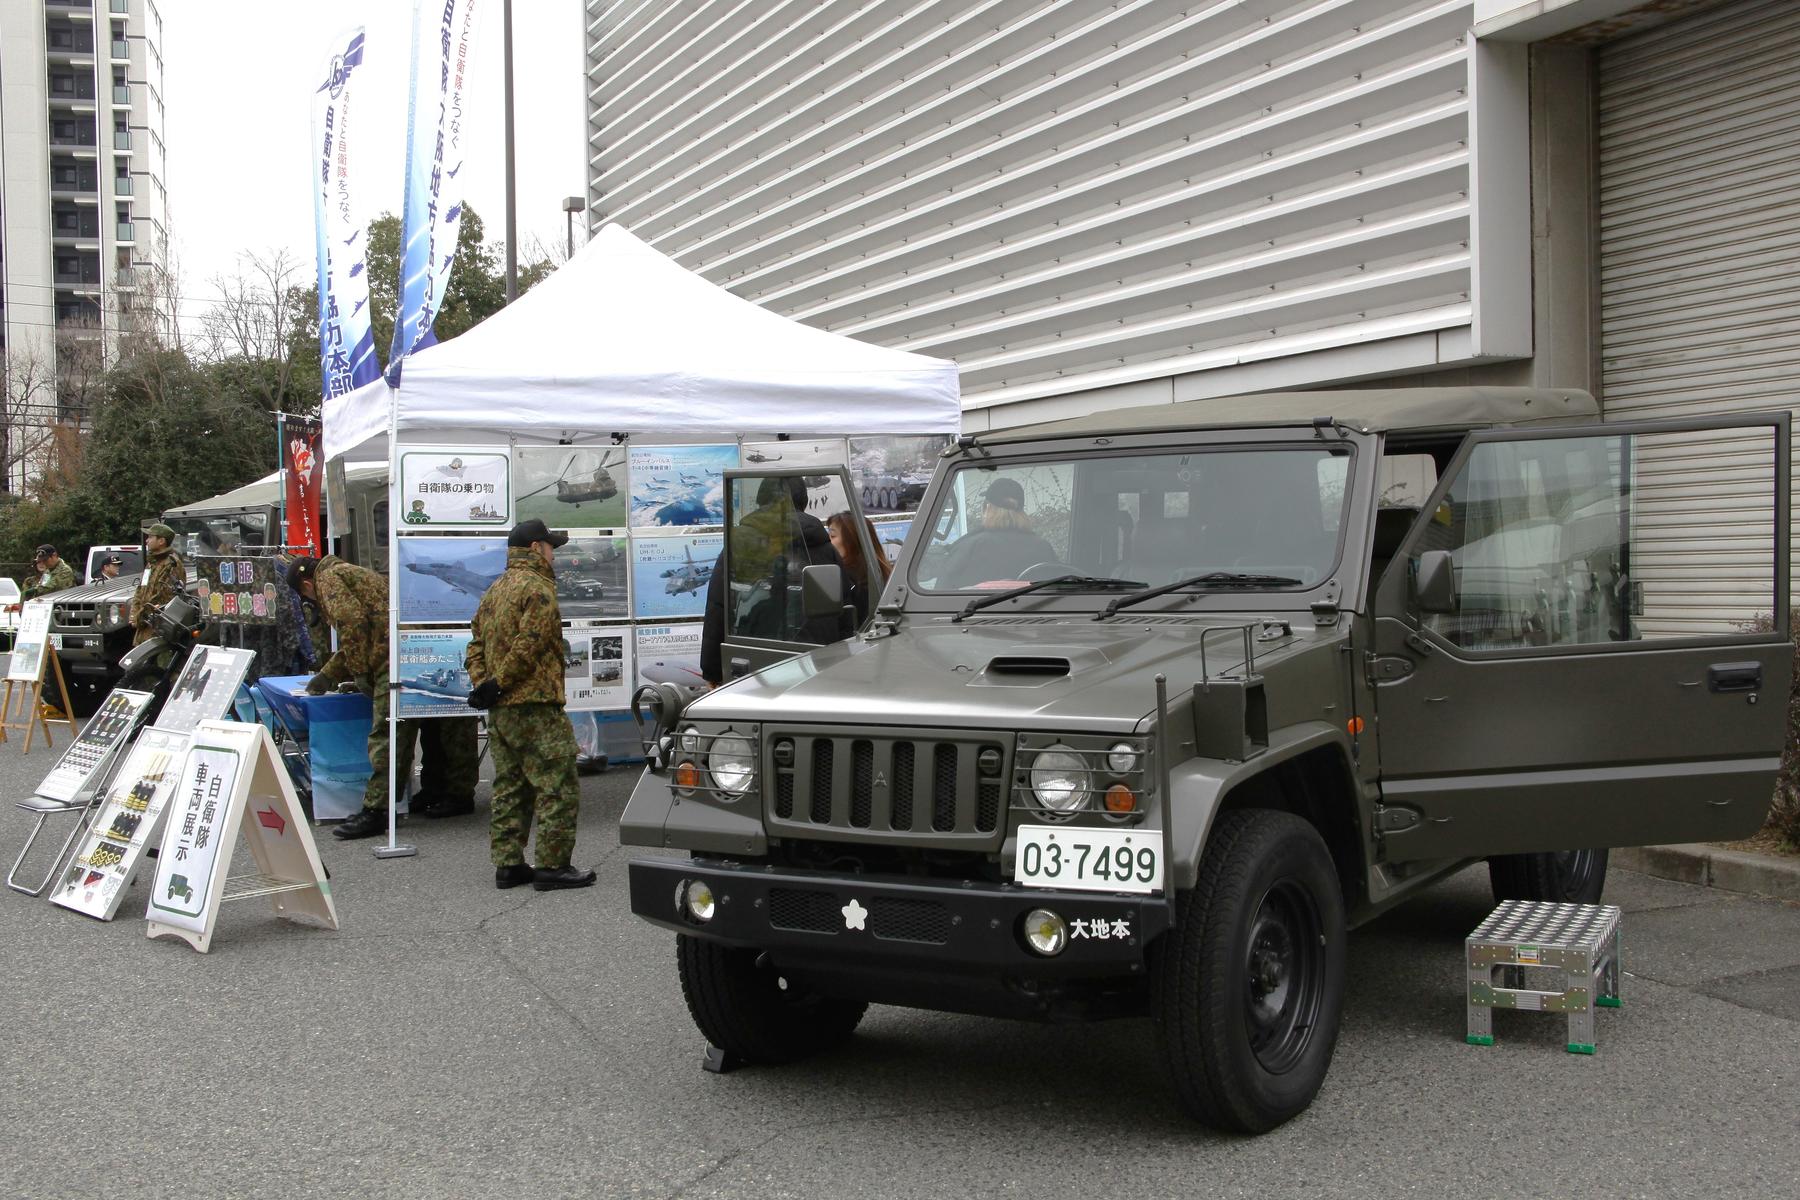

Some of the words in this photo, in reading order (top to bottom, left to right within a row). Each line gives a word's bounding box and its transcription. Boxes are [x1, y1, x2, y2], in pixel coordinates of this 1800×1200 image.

[418, 482, 494, 494] 自衛隊の乗り物
[220, 561, 254, 584] 制服
[175, 762, 209, 861] 車両展示
[194, 774, 222, 849] 自衛隊
[1023, 842, 1156, 883] 03-7499
[1070, 918, 1131, 939] 大地本
